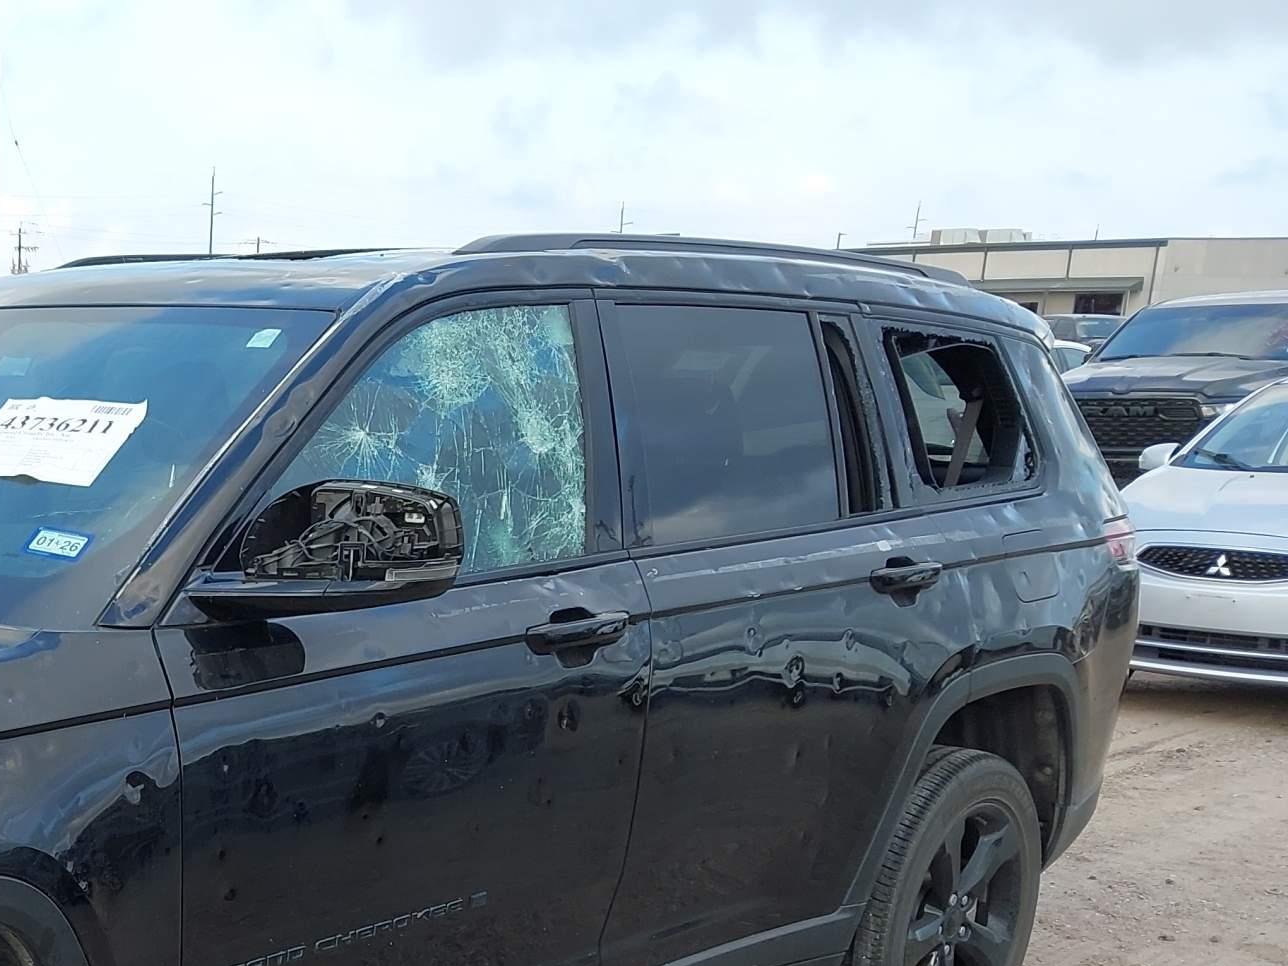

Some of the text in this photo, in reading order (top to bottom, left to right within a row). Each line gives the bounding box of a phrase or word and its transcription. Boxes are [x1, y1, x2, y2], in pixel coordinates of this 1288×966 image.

[1080, 405, 1156, 418] RAM
[0, 414, 115, 435] 43736211
[314, 897, 464, 954] CHEROKEE
